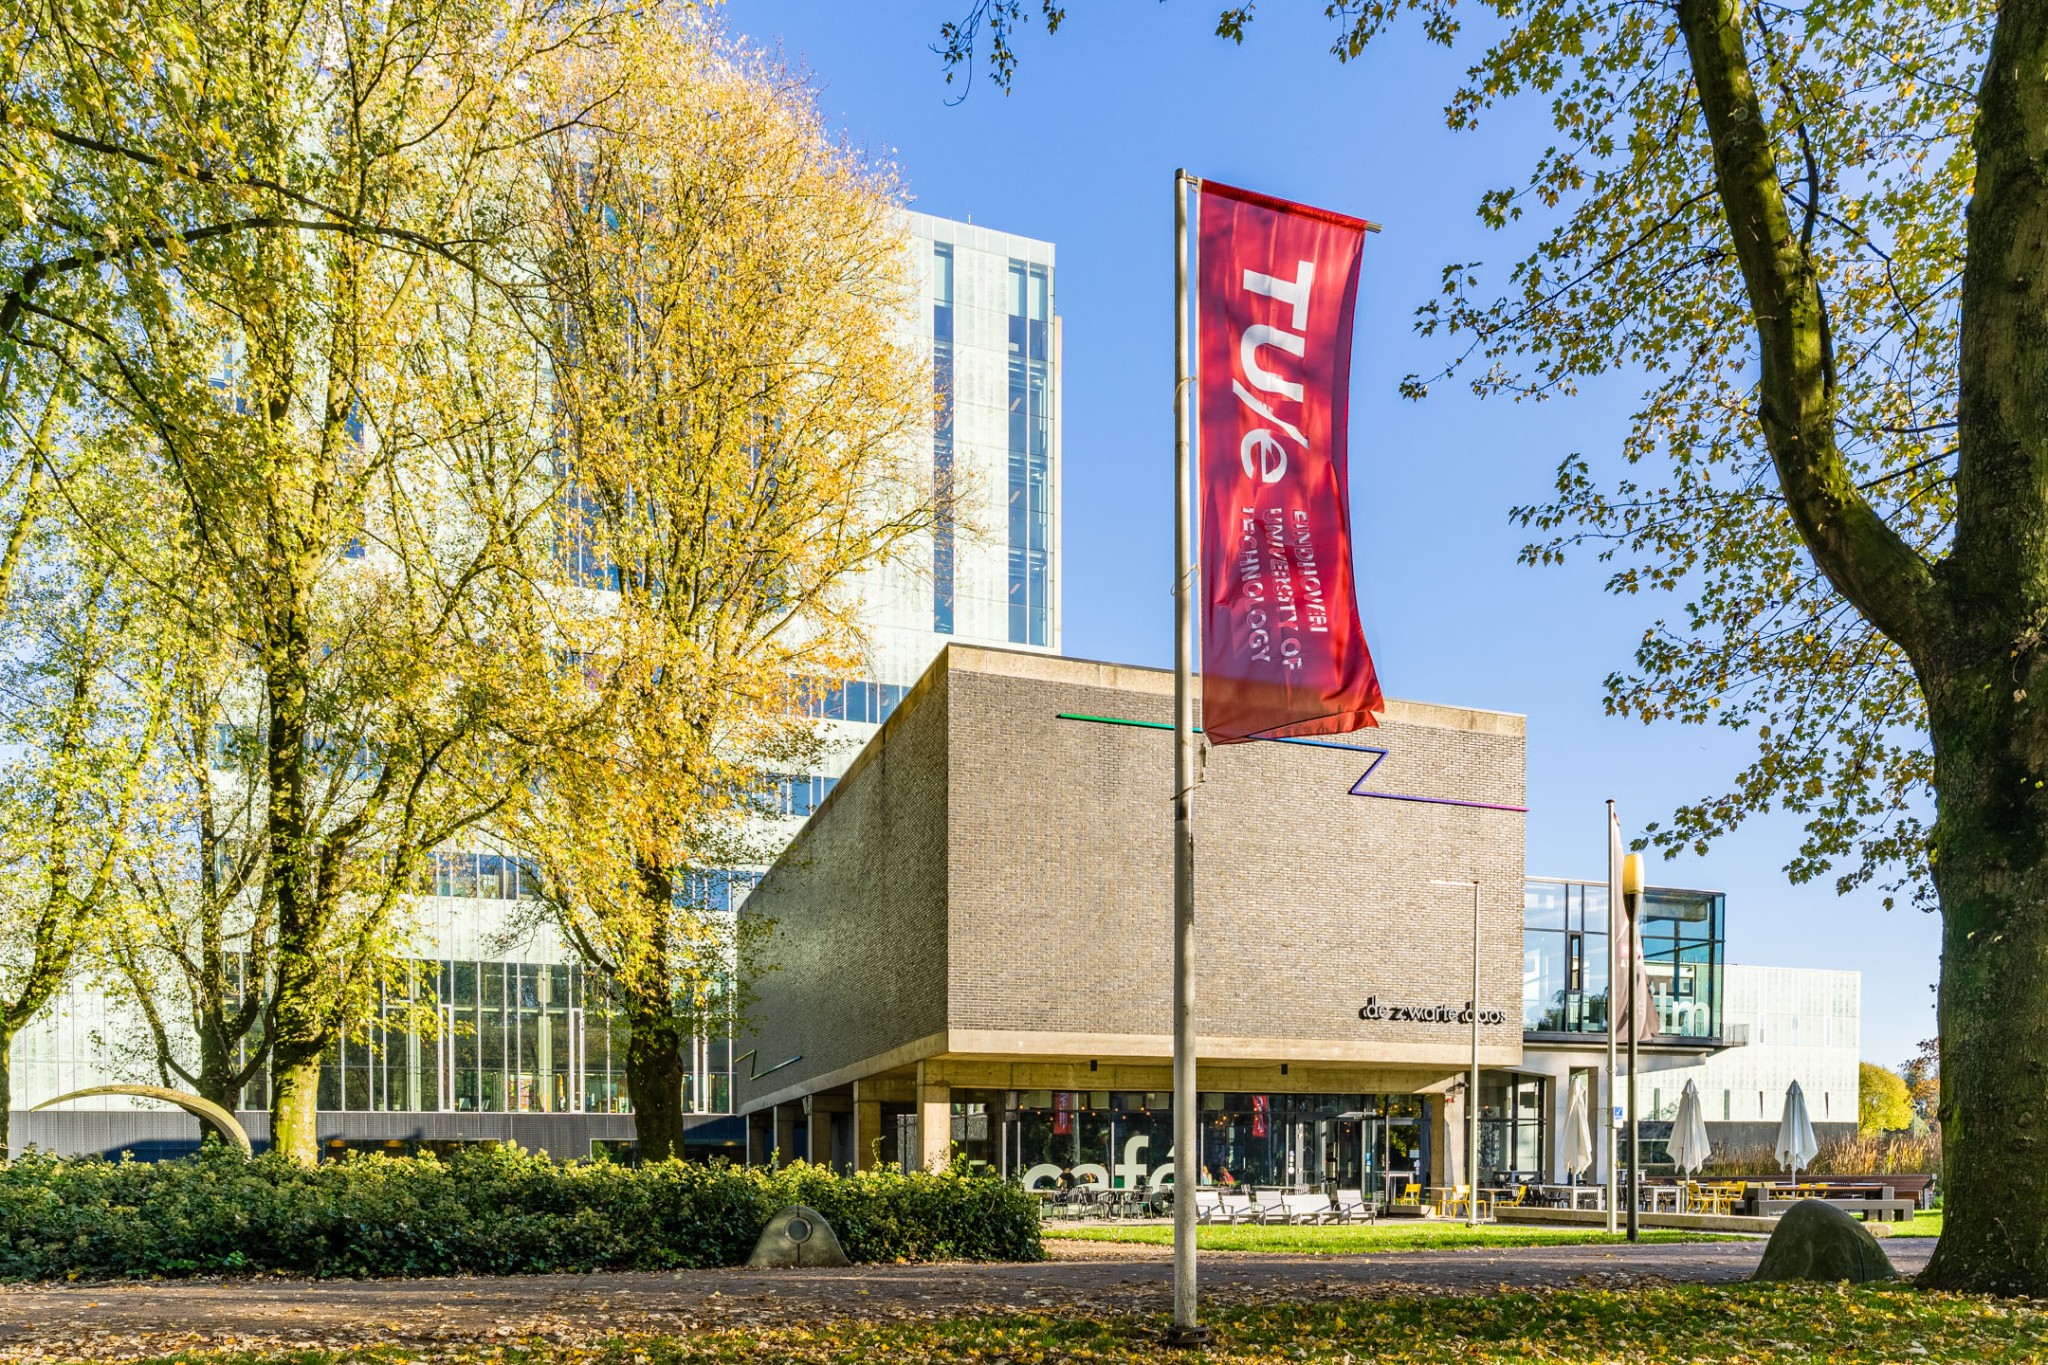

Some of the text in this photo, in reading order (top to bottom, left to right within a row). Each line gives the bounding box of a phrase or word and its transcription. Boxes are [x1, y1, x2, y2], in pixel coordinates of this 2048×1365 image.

[1232, 260, 1314, 483] TU/e
[1238, 506, 1271, 662] TECHNOLOGY
[1263, 507, 1302, 670] UNIVERSITY OF
